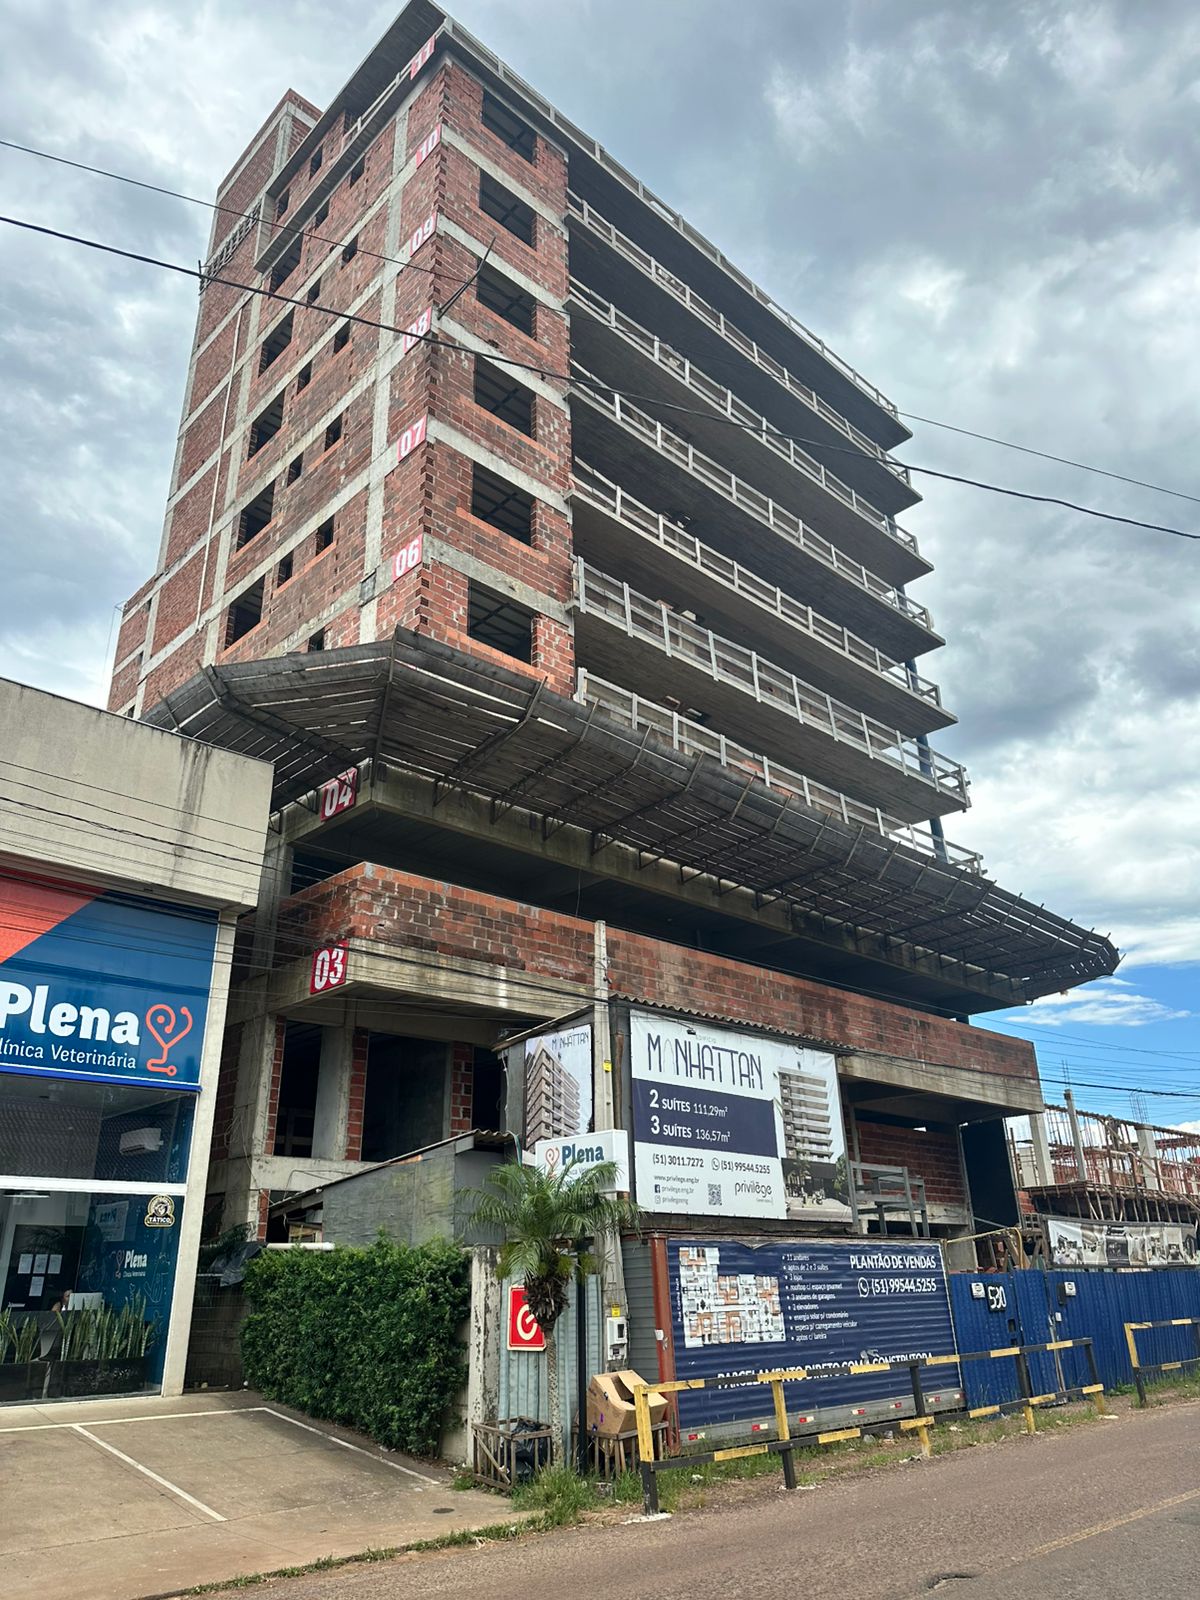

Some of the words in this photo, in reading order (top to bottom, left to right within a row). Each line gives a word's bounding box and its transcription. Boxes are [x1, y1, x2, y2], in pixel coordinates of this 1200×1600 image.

[419, 129, 438, 161] 10
[411, 217, 435, 251] 09
[406, 310, 428, 351] 08
[401, 418, 425, 457] 07
[395, 541, 420, 578] 06
[324, 771, 354, 817] 04
[314, 944, 344, 990] 03
[0, 980, 141, 1046] Plena
[0, 1038, 44, 1060] línica
[51, 1044, 137, 1069] Veterinária
[649, 1089, 659, 1108] 2
[661, 1098, 691, 1113] SUÍTES
[650, 1115, 660, 1134] 3
[662, 1124, 692, 1139] SUÍTES
[562, 1143, 604, 1166] Plena
[652, 1153, 667, 1165] (51)
[721, 1160, 733, 1172] (51)
[124, 1249, 147, 1268] Plena
[850, 1253, 891, 1269] PLANTÃO
[892, 1255, 904, 1269] DE
[904, 1255, 937, 1269] VENDAS
[872, 1278, 888, 1296] (51)
[889, 1278, 937, 1293] 99544.5255
